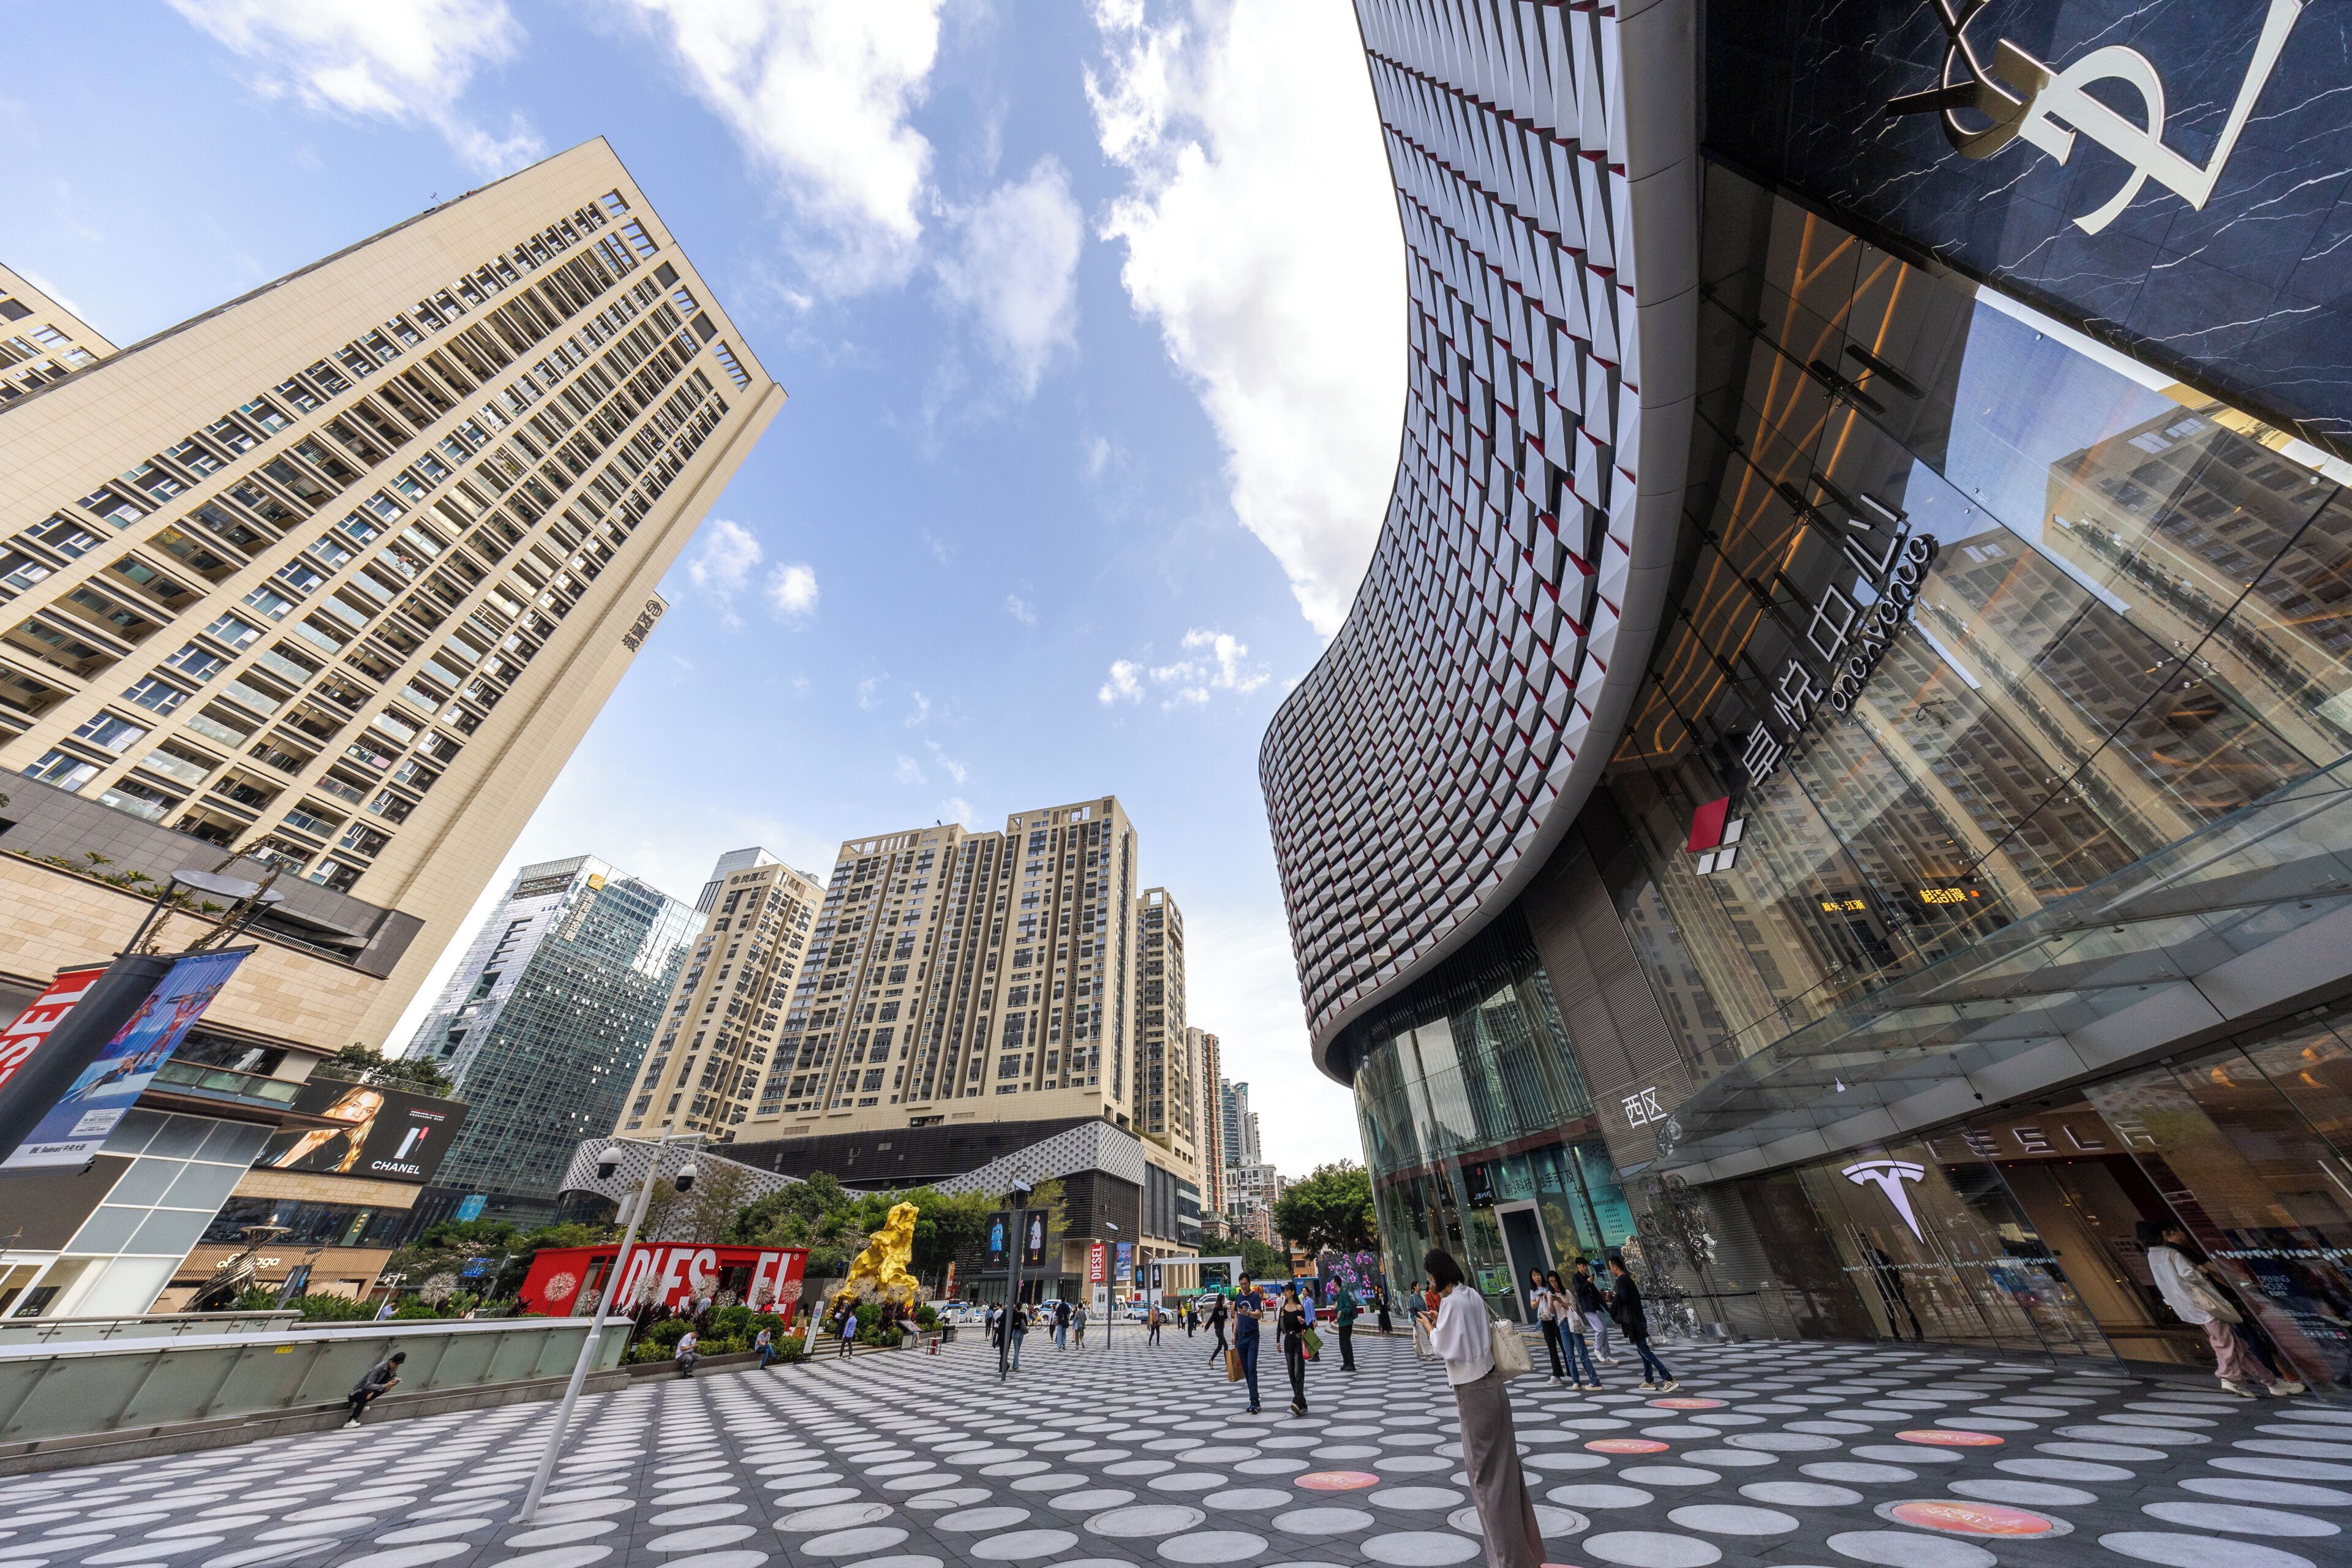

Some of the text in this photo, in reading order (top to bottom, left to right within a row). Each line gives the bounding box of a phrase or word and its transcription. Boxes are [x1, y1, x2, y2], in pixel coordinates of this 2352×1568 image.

[1742, 492, 1908, 787] 卓悦中心
[0, 979, 98, 1085] SEL
[1621, 1085, 1667, 1129] 西区
[1926, 1120, 2162, 1159] TESLA
[371, 1160, 420, 1175] CHANEL
[1091, 1245, 1102, 1280] DIESEL
[2256, 1275, 2290, 1283] OPENING
